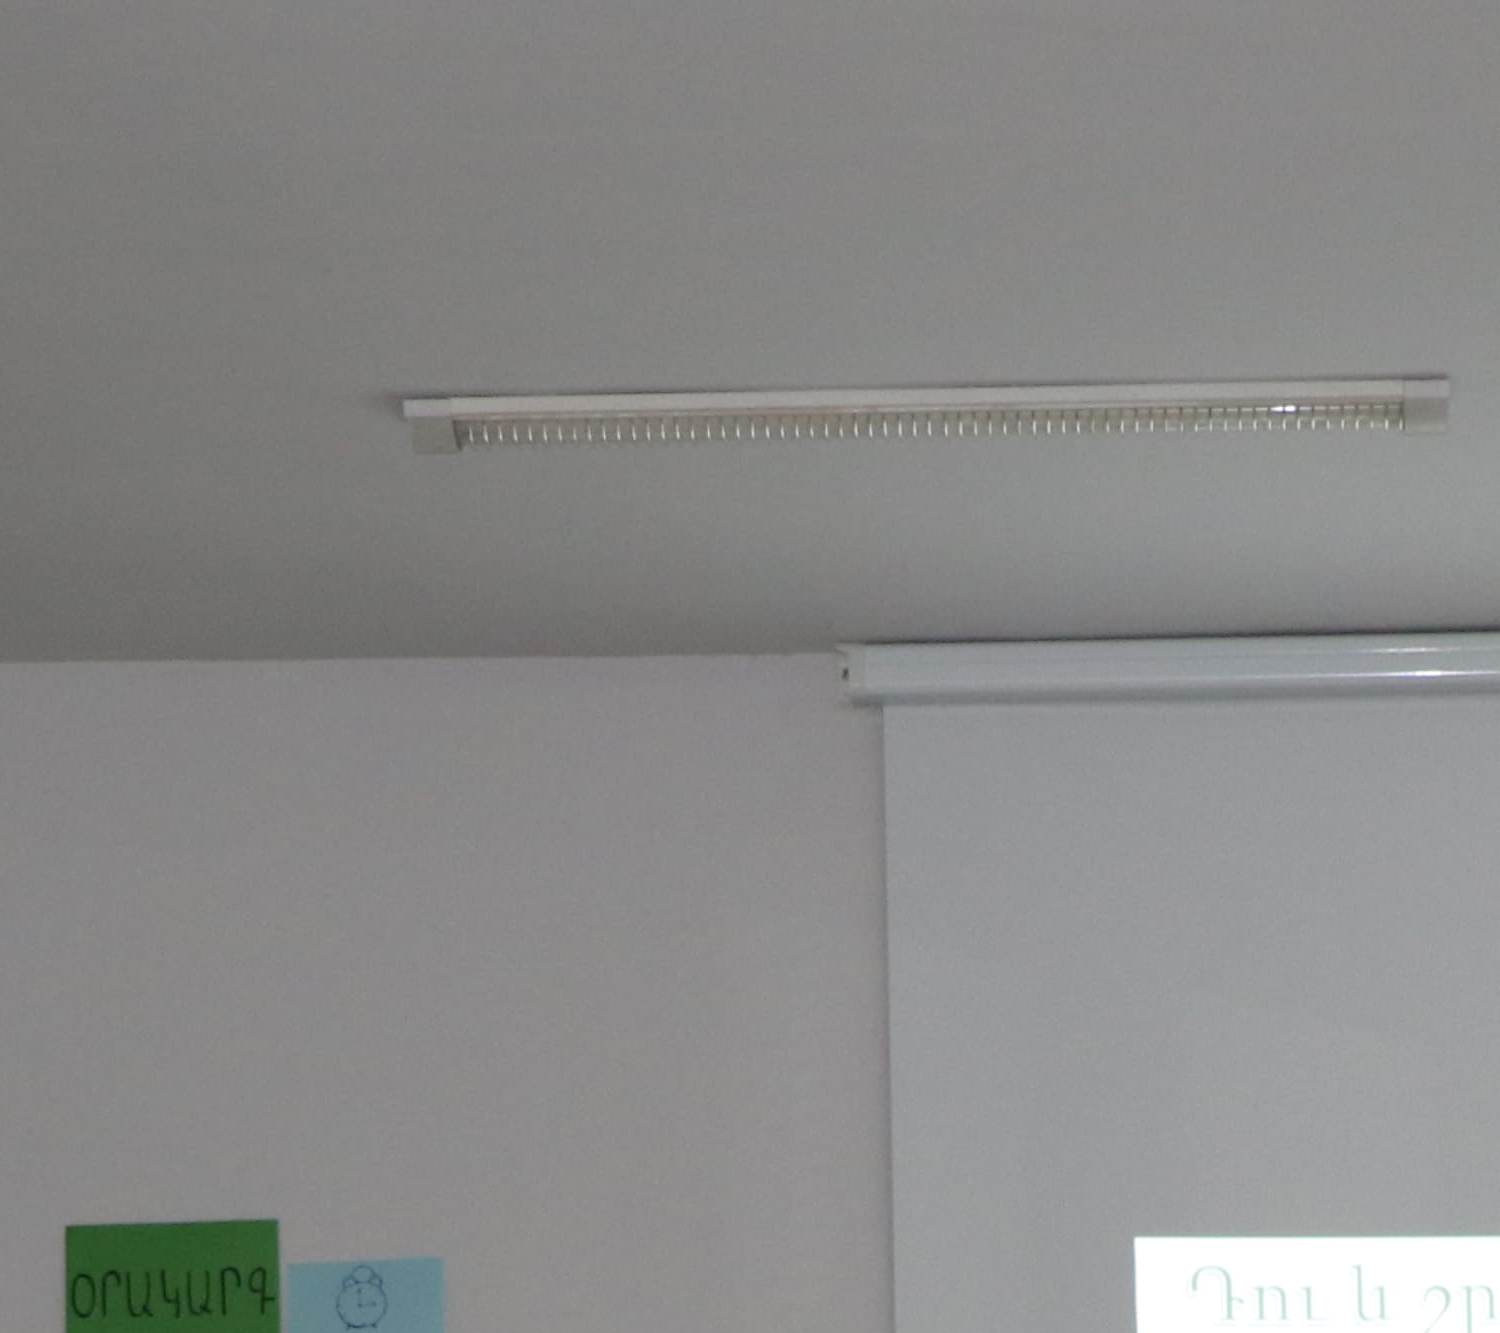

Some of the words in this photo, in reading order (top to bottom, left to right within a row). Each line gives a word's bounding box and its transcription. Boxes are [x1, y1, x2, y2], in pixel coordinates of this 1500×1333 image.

[70, 1267, 277, 1319] ՕՐԱԿԱՐԳ
[1190, 1264, 1324, 1325] Դու
[1352, 1264, 1390, 1323] և
